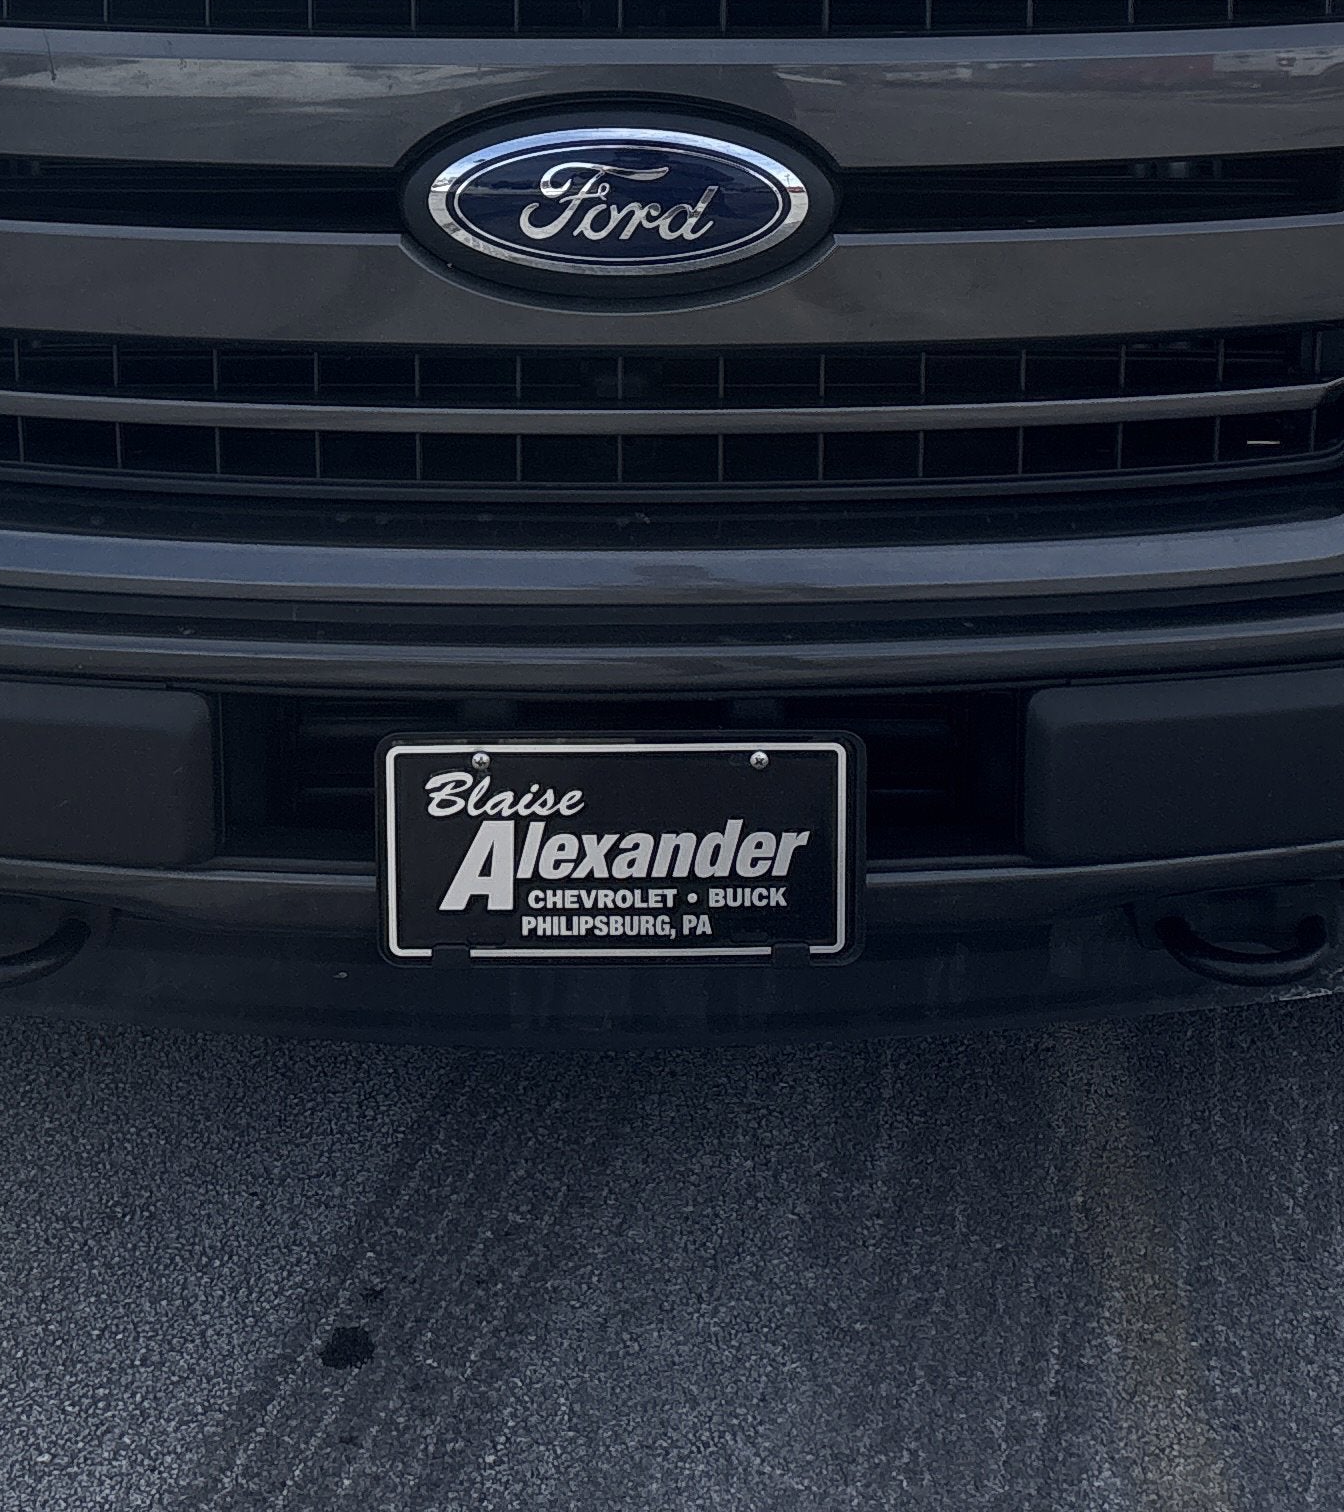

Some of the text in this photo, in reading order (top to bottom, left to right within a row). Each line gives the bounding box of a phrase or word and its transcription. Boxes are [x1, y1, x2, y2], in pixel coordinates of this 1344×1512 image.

[519, 161, 718, 241] Ford
[425, 772, 584, 817] Blaise
[439, 819, 811, 911] Alexander
[527, 887, 788, 909] CHEVROLET BUICK
[521, 915, 713, 939] PHILIPSBURG, PA
